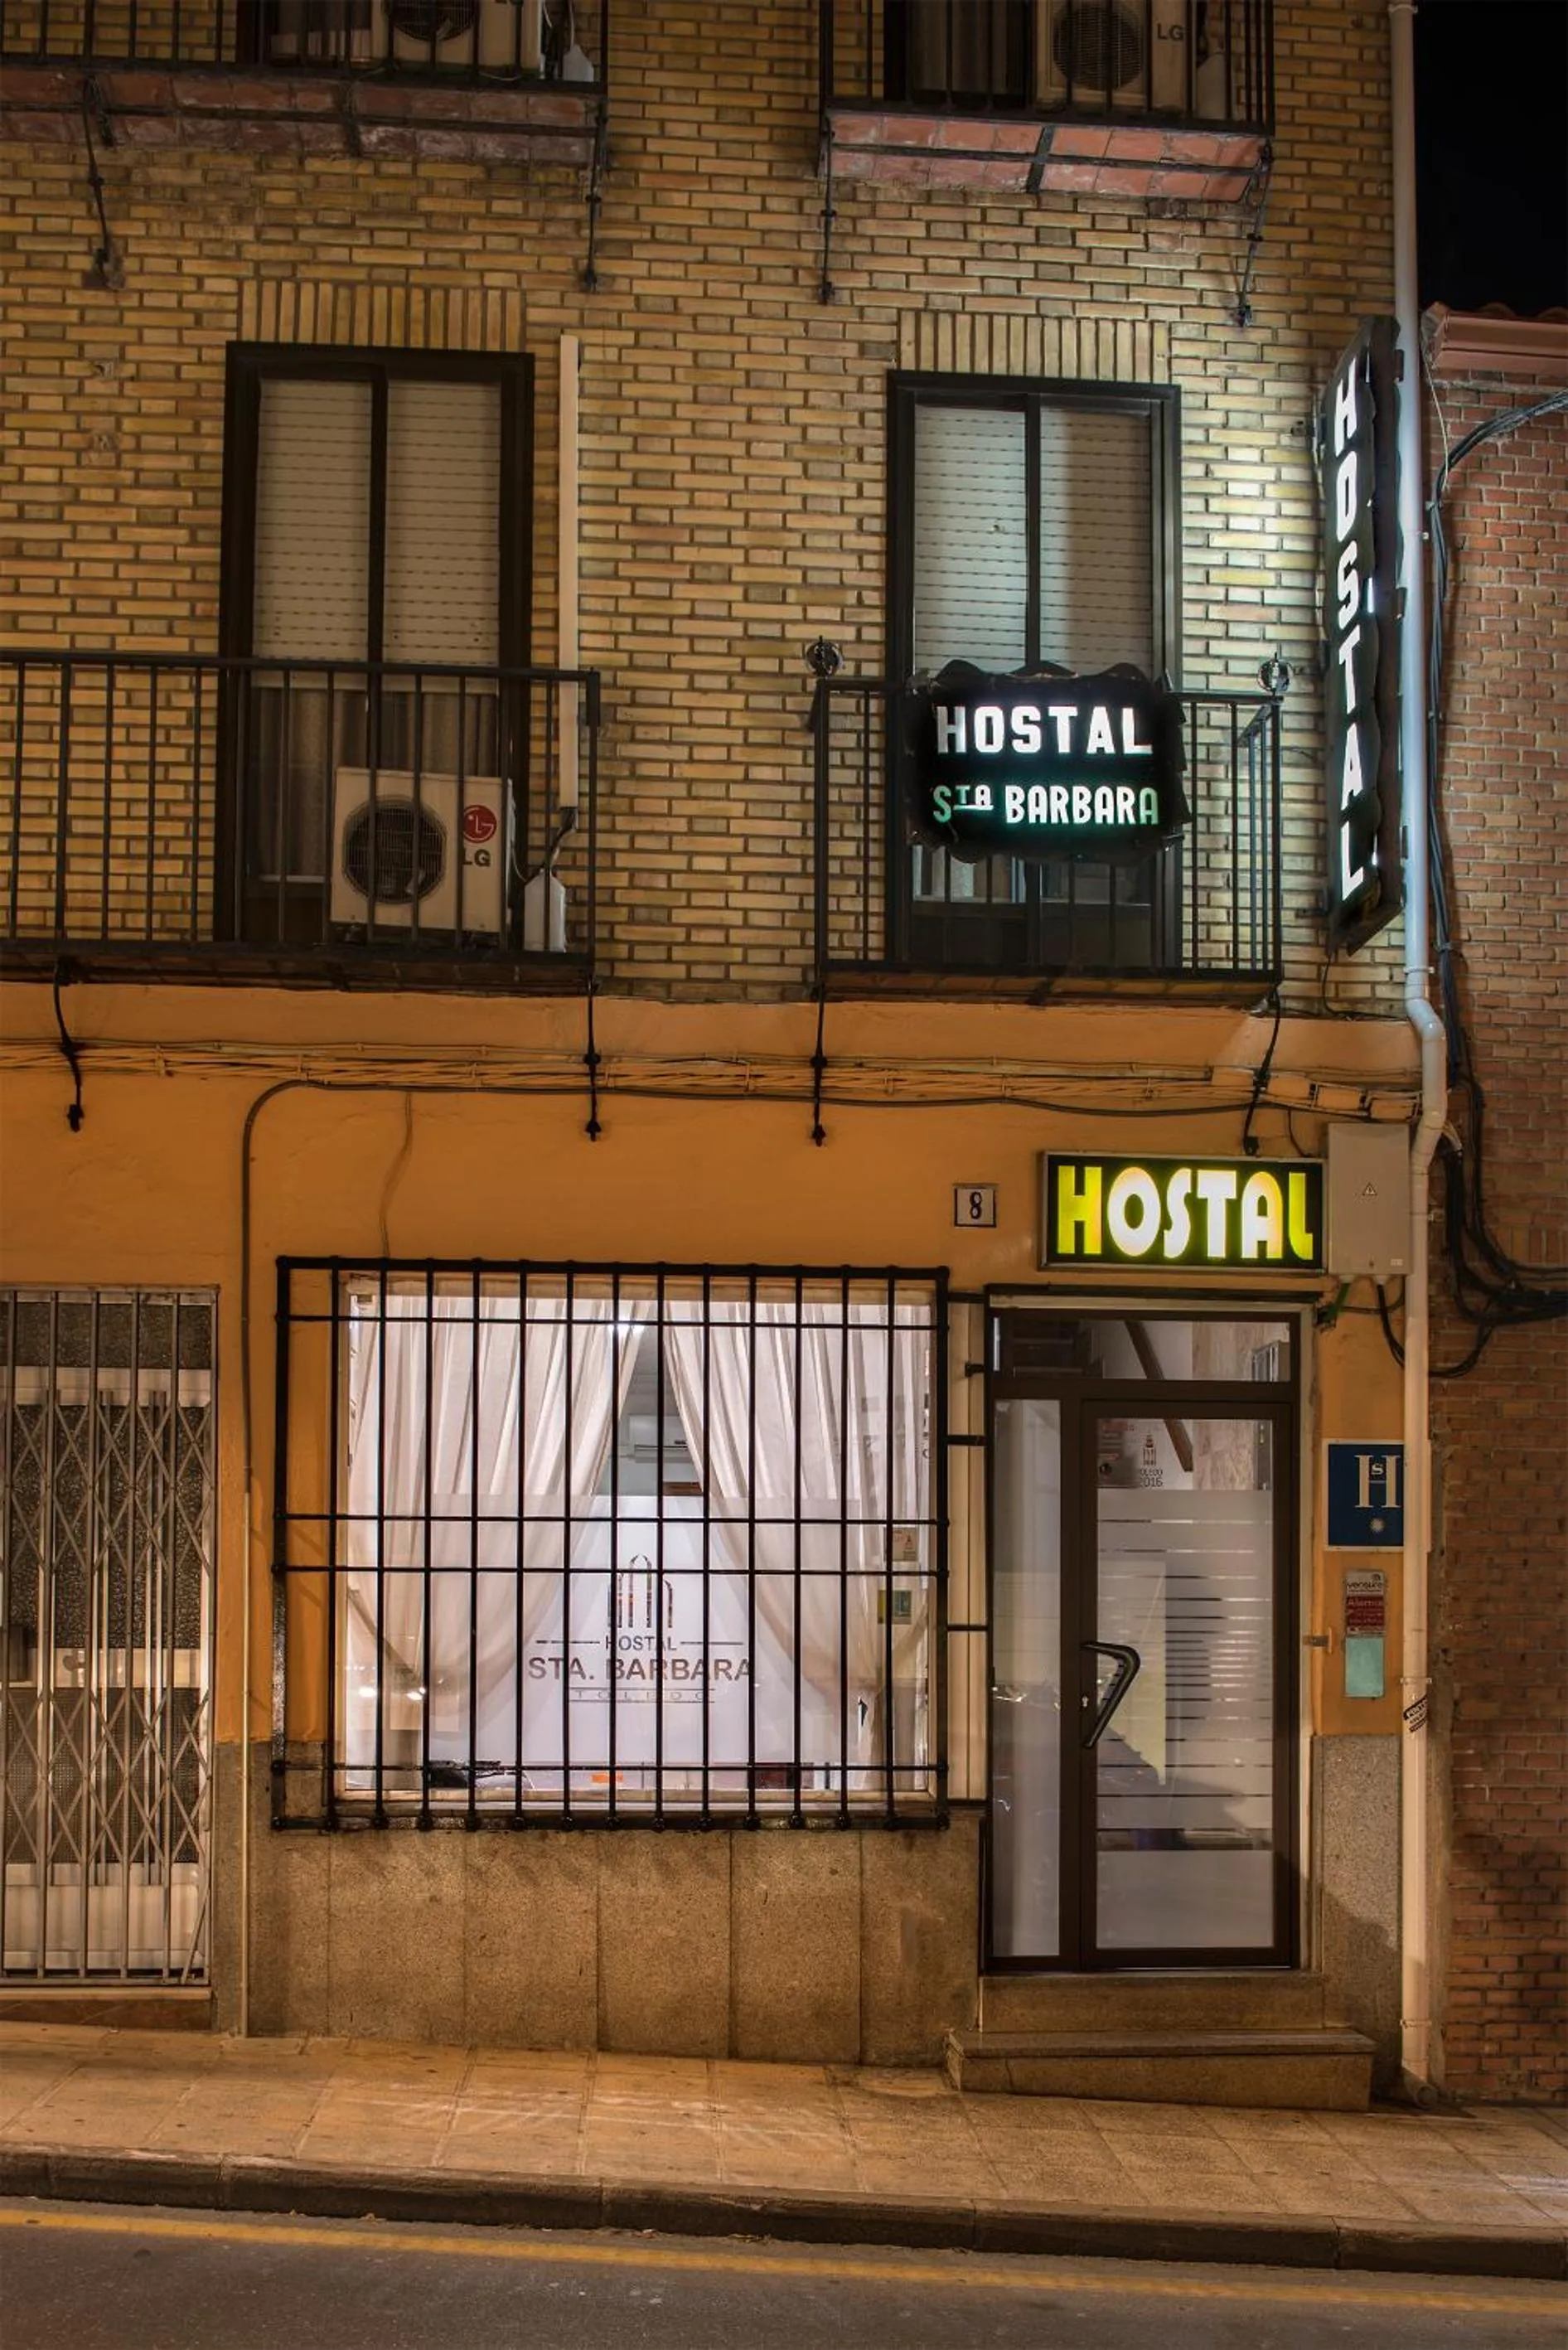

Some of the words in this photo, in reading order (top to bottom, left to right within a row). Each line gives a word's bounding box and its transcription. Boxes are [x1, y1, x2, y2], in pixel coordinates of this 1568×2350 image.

[1157, 22, 1184, 41] LG
[1334, 359, 1364, 901] HOSTAL
[936, 705, 1154, 754] HOSTAL
[1004, 785, 1159, 825] BARBARA
[970, 1191, 983, 1219] 8
[1057, 1165, 1314, 1260] HOSTAL
[606, 1658, 753, 1681] BARBARA
